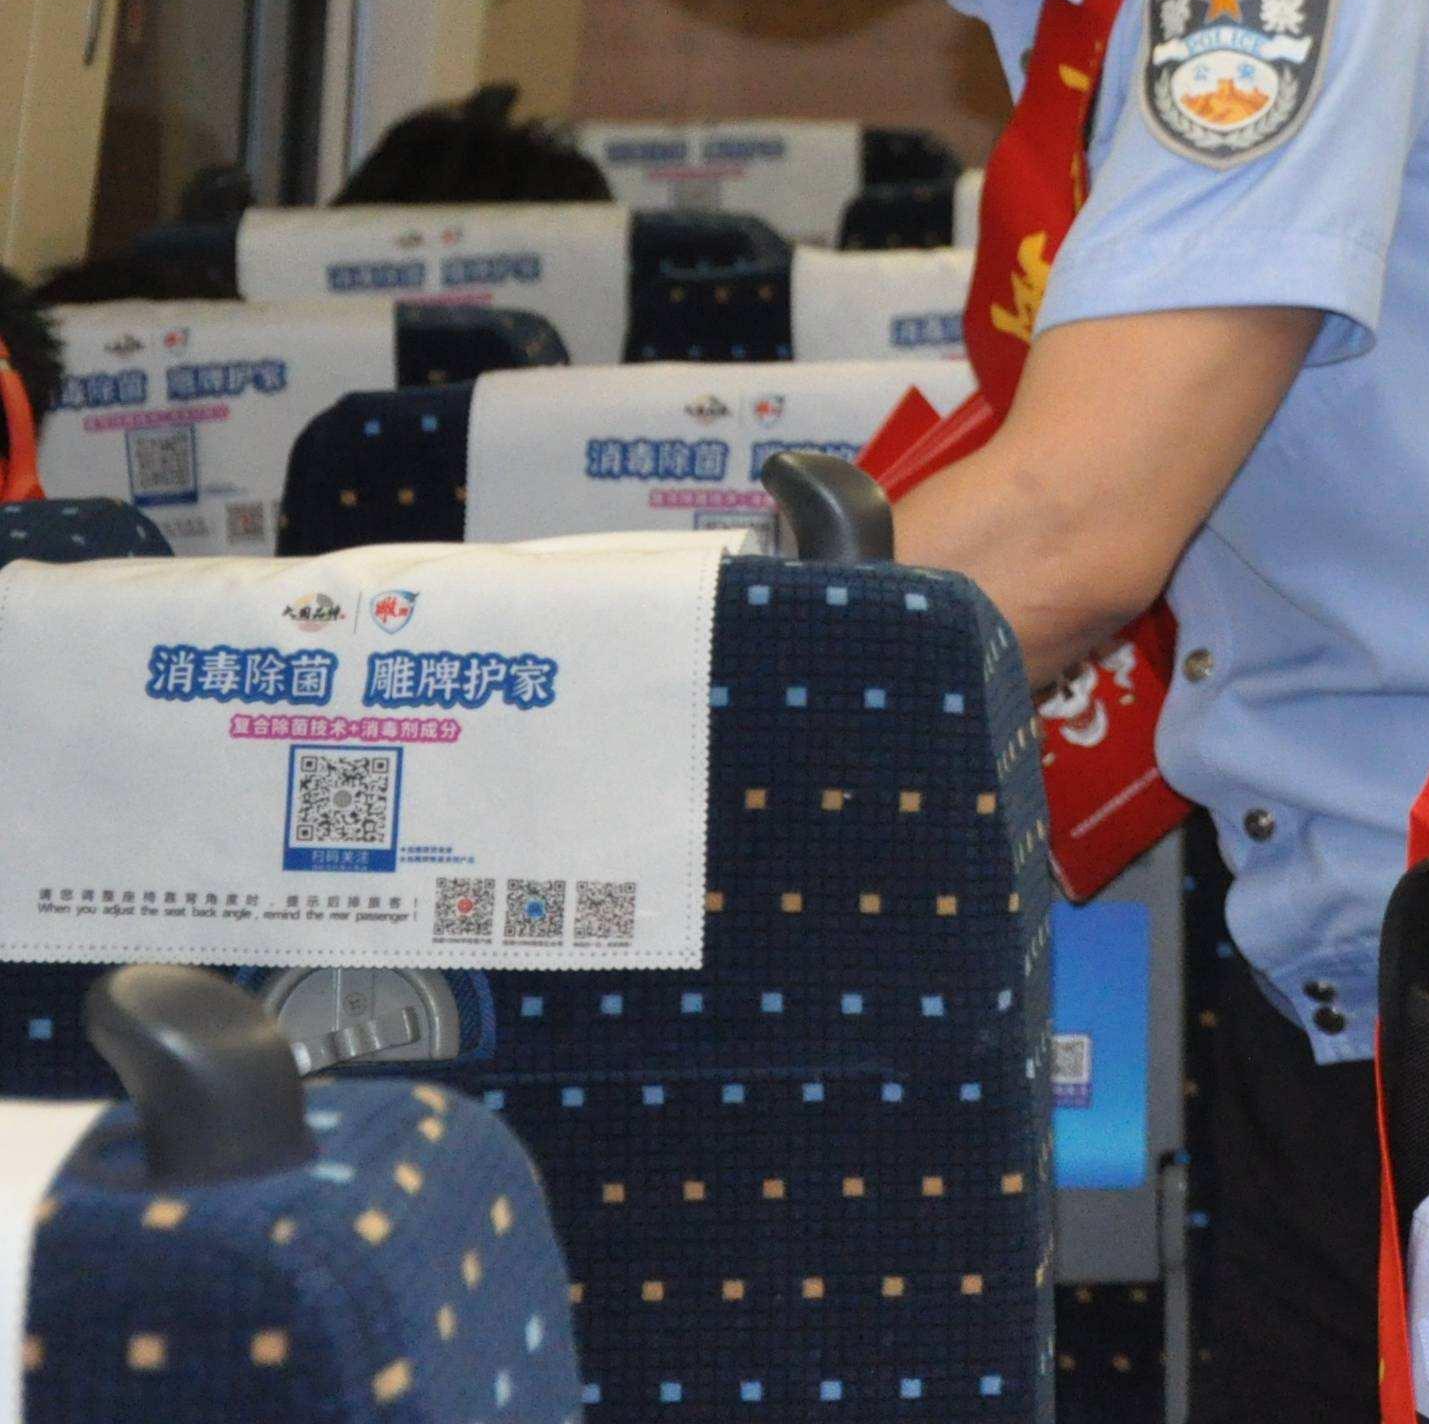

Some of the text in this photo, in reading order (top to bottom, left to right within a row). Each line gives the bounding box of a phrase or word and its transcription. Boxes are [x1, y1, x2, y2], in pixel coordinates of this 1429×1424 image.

[149, 646, 557, 707] 消毒除菌 雕牌护家
[230, 714, 461, 742] 复合除菌技术+消毒剂成分
[38, 902, 71, 915] When
[76, 905, 97, 917] you
[102, 904, 135, 918] adjust
[141, 905, 159, 916] the
[164, 906, 187, 917] seat
[192, 905, 217, 918] back
[263, 908, 301, 921] remind
[306, 909, 324, 921] the
